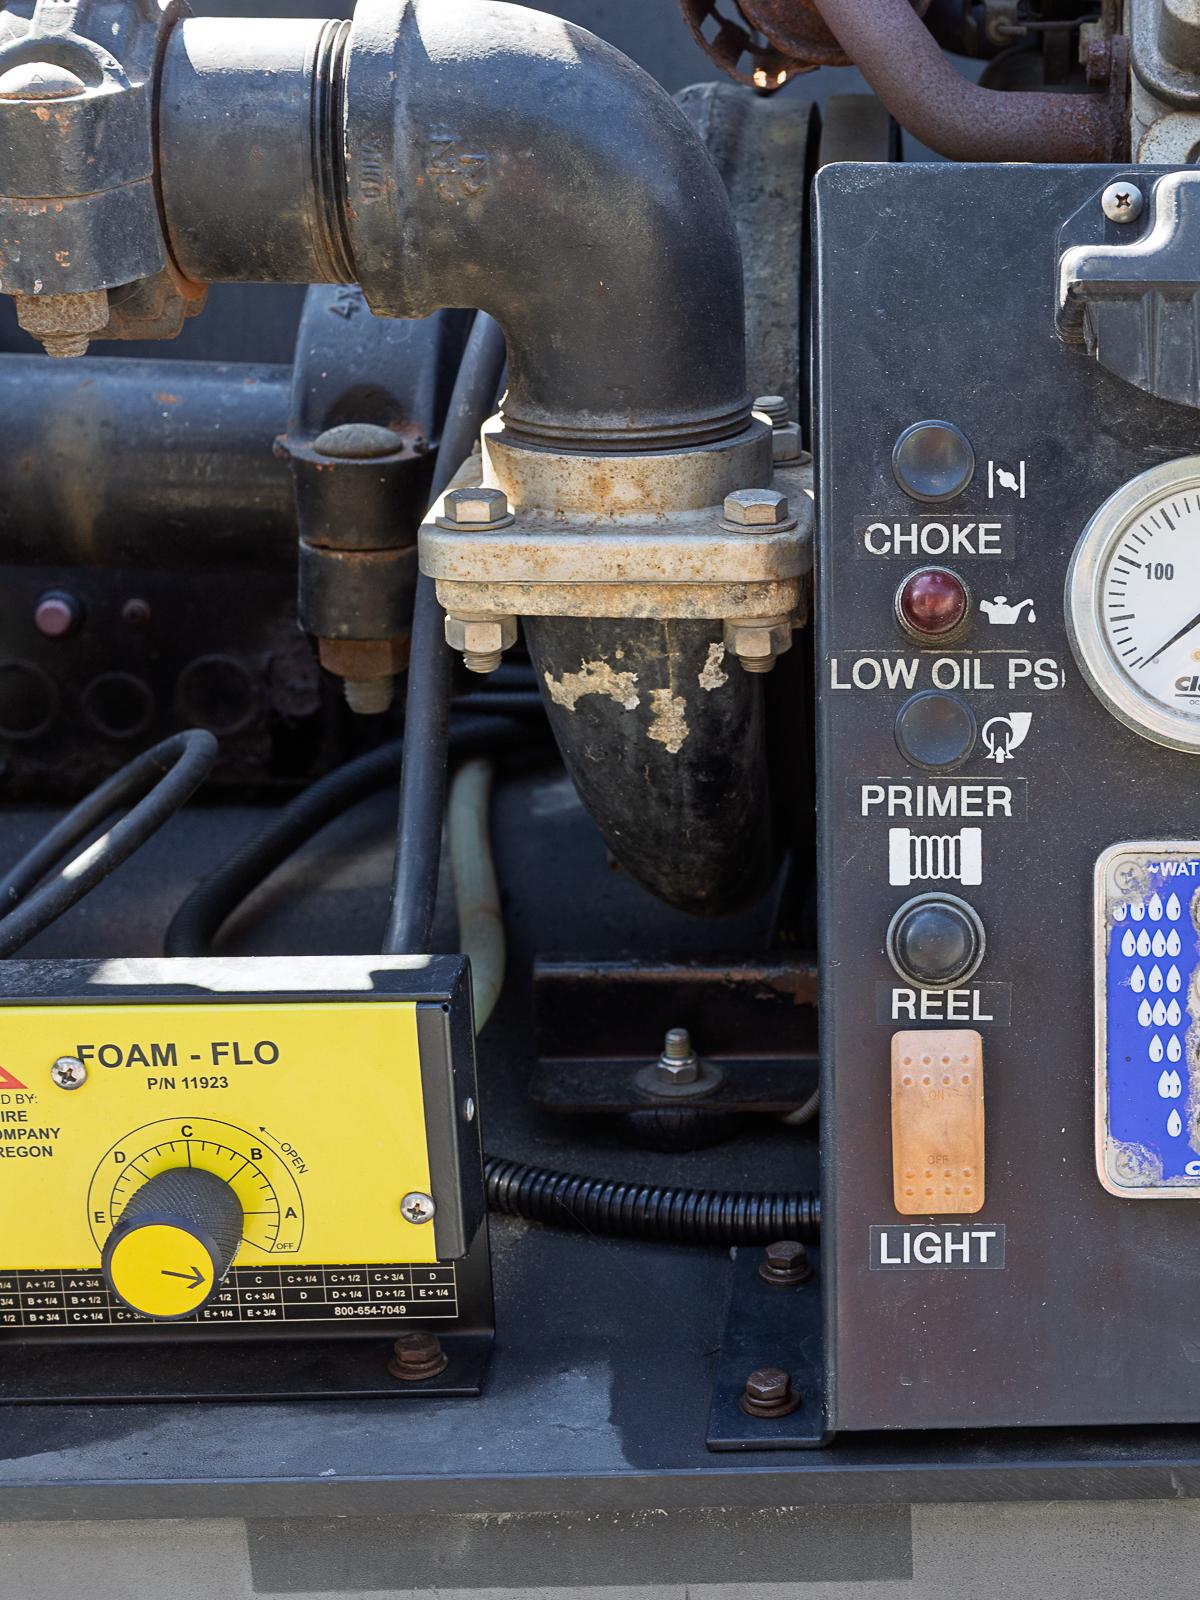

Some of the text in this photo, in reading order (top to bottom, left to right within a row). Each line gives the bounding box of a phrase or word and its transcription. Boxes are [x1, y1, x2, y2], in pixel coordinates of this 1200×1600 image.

[864, 523, 1002, 555] CHOKE
[1144, 562, 1174, 581] 100
[831, 658, 919, 690] LOW
[932, 657, 994, 690] OIL
[861, 785, 1012, 817] PRIMER
[891, 988, 993, 1021] REEL
[76, 1043, 177, 1068] FOAM
[211, 1040, 280, 1066] FLO
[147, 1075, 229, 1090] P/N 11923
[16, 1093, 38, 1105] BY:
[181, 1125, 194, 1139] C
[113, 1147, 263, 1163] D B
[280, 1141, 309, 1175] OPEN
[95, 1206, 298, 1224] E A
[276, 1242, 294, 1250] OFF
[880, 1231, 996, 1264] LIGHT
[255, 1276, 262, 1284] C
[303, 1275, 317, 1283] 1/4
[347, 1274, 360, 1282] 1/2
[375, 1273, 404, 1282] C 3/4
[429, 1273, 436, 1281] D
[26, 1280, 55, 1289] A 1/2
[70, 1280, 99, 1288] A 3/4
[262, 1291, 275, 1300] 3/4
[332, 1290, 362, 1299] D 1/4
[376, 1290, 405, 1298] D 1/2
[419, 1288, 448, 1297] E 1/4
[44, 1297, 57, 1305] 1/4
[88, 1296, 101, 1304] 1/2
[204, 1309, 233, 1318] E 1/4
[247, 1308, 276, 1317] E 3/4
[334, 1305, 406, 1316] 800-654-7049
[29, 1313, 59, 1322] B 3/4
[73, 1312, 103, 1321] C 1/4
